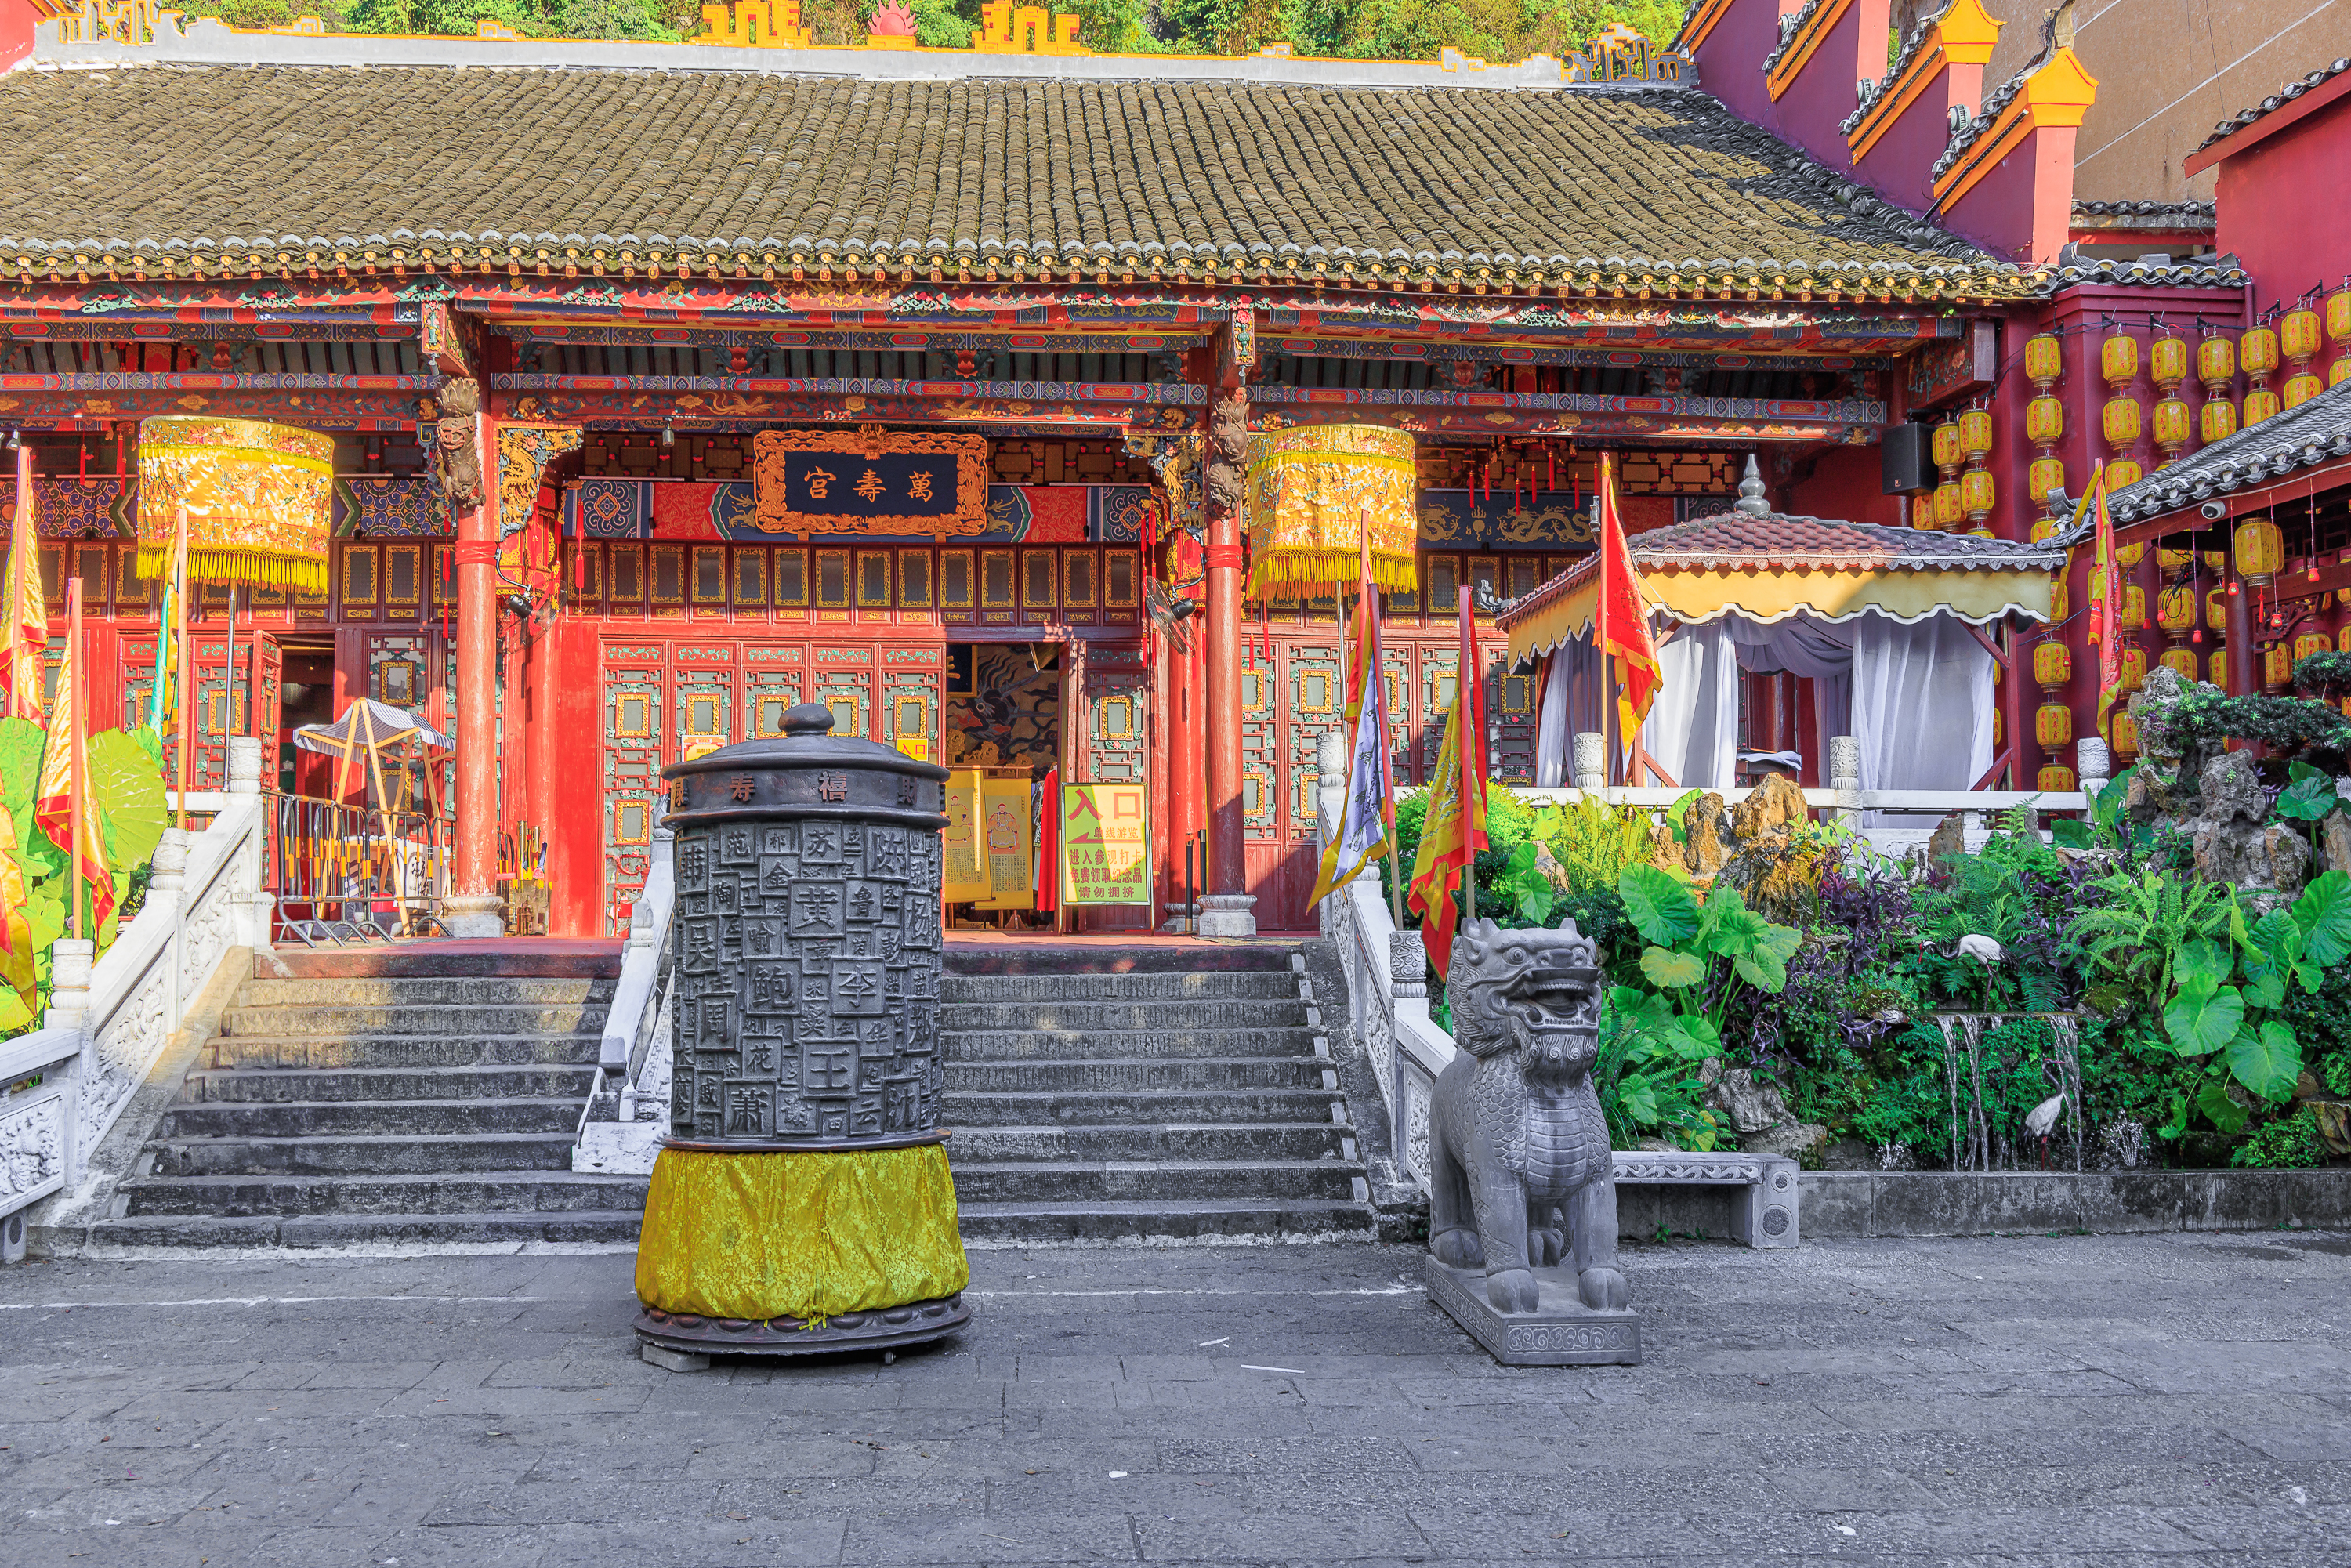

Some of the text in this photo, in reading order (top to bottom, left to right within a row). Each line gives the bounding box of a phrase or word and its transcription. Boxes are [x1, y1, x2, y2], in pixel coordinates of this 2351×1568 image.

[900, 744, 926, 755] 入口
[730, 773, 757, 802] 寿
[819, 771, 849, 802] 禧
[1067, 788, 1141, 821] 入口
[808, 827, 835, 857] 苏
[1094, 827, 1139, 839] 单线游览
[871, 830, 905, 873] 陈
[1069, 849, 1143, 866] 进入参观打卡
[763, 862, 794, 889] 金
[1070, 867, 1143, 884] 免费领取纪念品
[795, 885, 839, 929] 黄
[850, 885, 875, 917] 鲁
[1078, 886, 1135, 898] 请勿拥挤
[686, 923, 716, 965] 吴
[752, 965, 795, 1008] 鲍
[839, 964, 877, 1008] 李
[701, 1001, 730, 1043] 周
[748, 1043, 774, 1072] 花
[807, 1048, 852, 1089] 王
[889, 1087, 917, 1128] 沈
